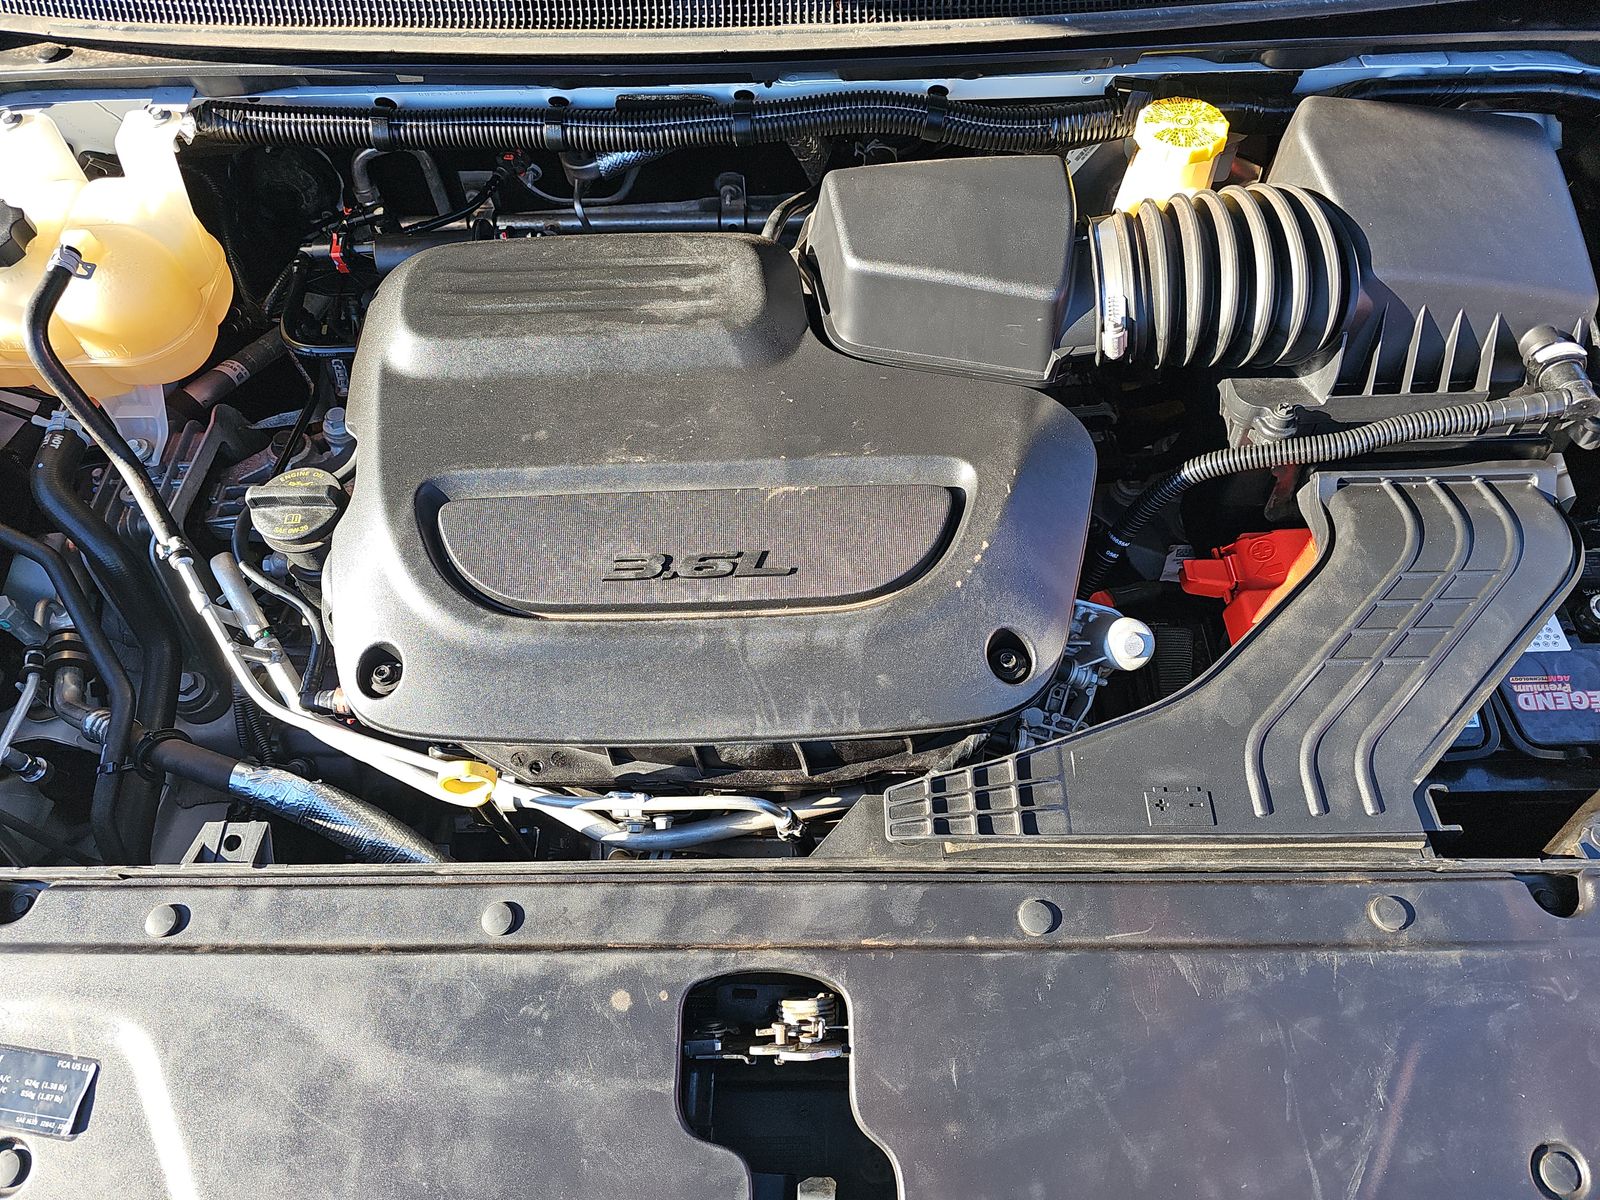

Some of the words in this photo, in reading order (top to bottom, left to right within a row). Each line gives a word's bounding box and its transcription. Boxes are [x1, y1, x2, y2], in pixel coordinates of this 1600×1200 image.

[280, 471, 310, 481] ENGINE
[312, 471, 325, 479] OIL
[602, 550, 799, 582] 3.6L
[1512, 683, 1572, 693] Premium
[57, 1061, 70, 1069] FCA
